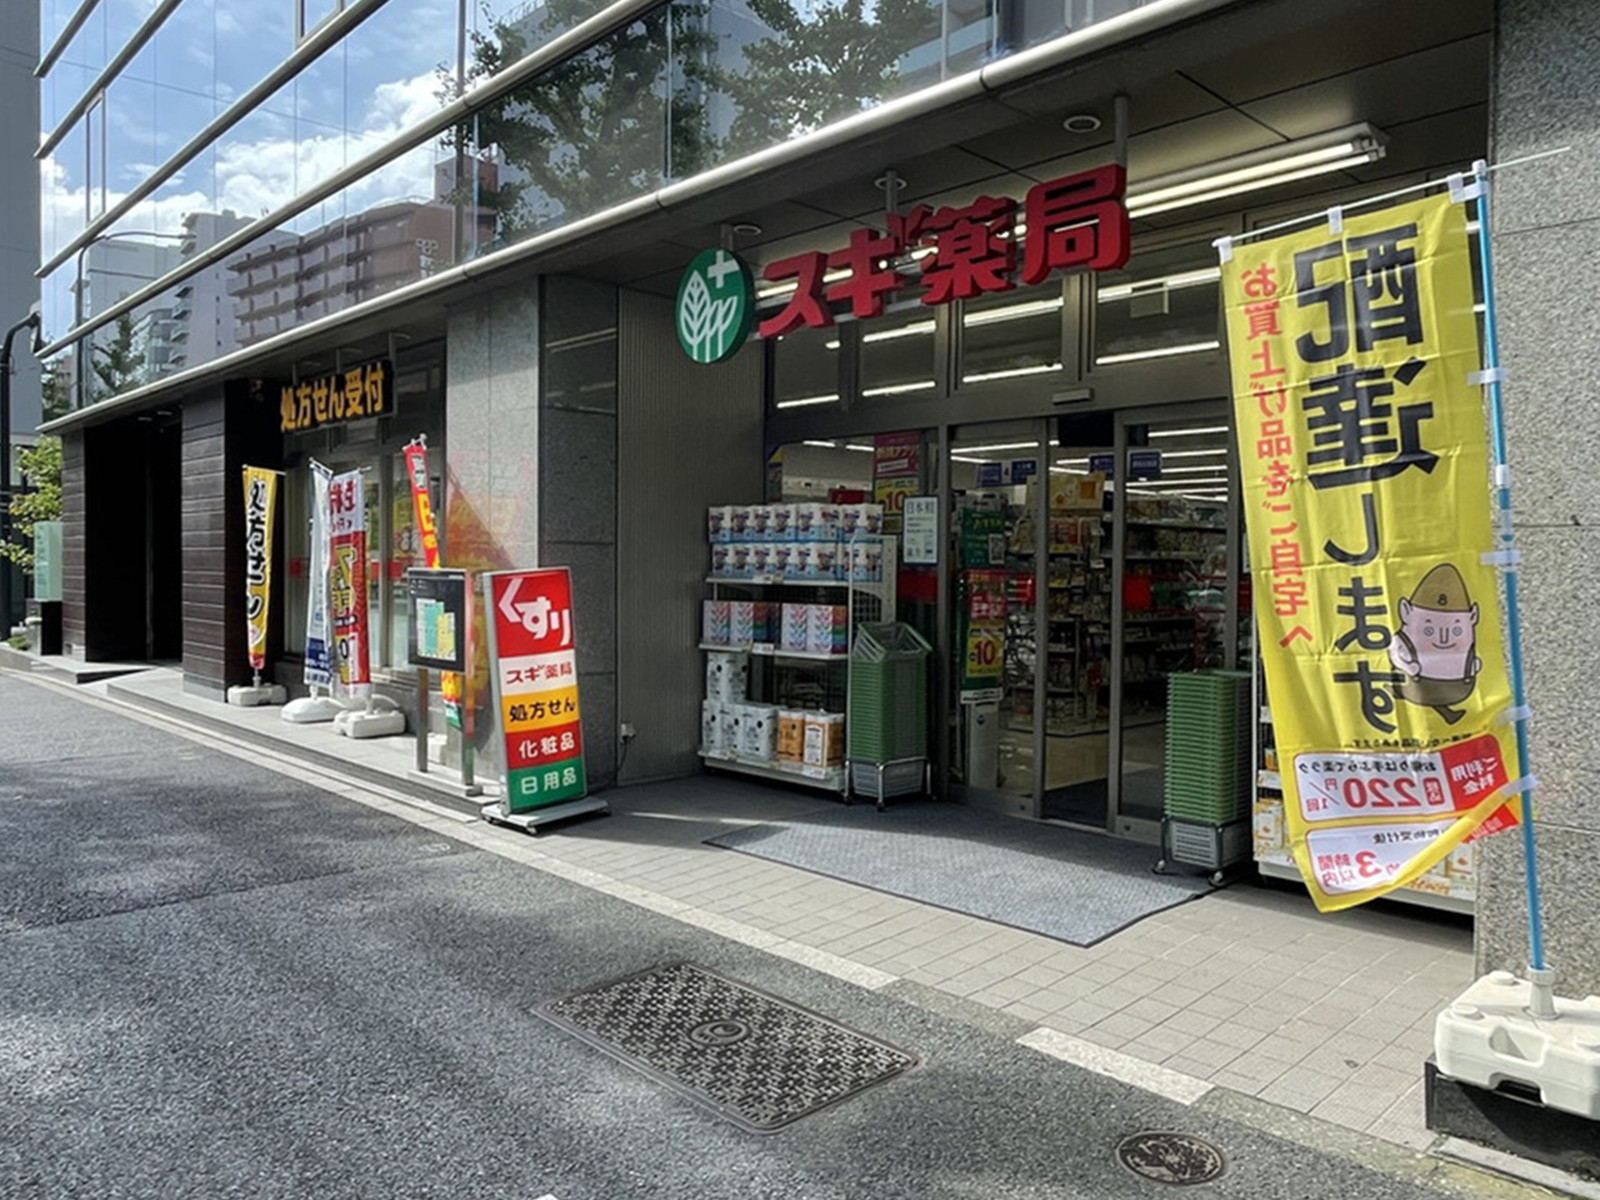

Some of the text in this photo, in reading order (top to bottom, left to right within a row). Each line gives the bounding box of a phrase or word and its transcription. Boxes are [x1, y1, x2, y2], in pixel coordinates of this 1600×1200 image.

[757, 164, 1131, 338] スギ薬局
[281, 361, 384, 433] 処方せん受付
[499, 578, 571, 647] くすり
[506, 661, 573, 685] スギ薬局
[509, 697, 576, 722] 処方せん
[519, 731, 576, 759] 化粧品
[520, 767, 577, 795] 日用品
